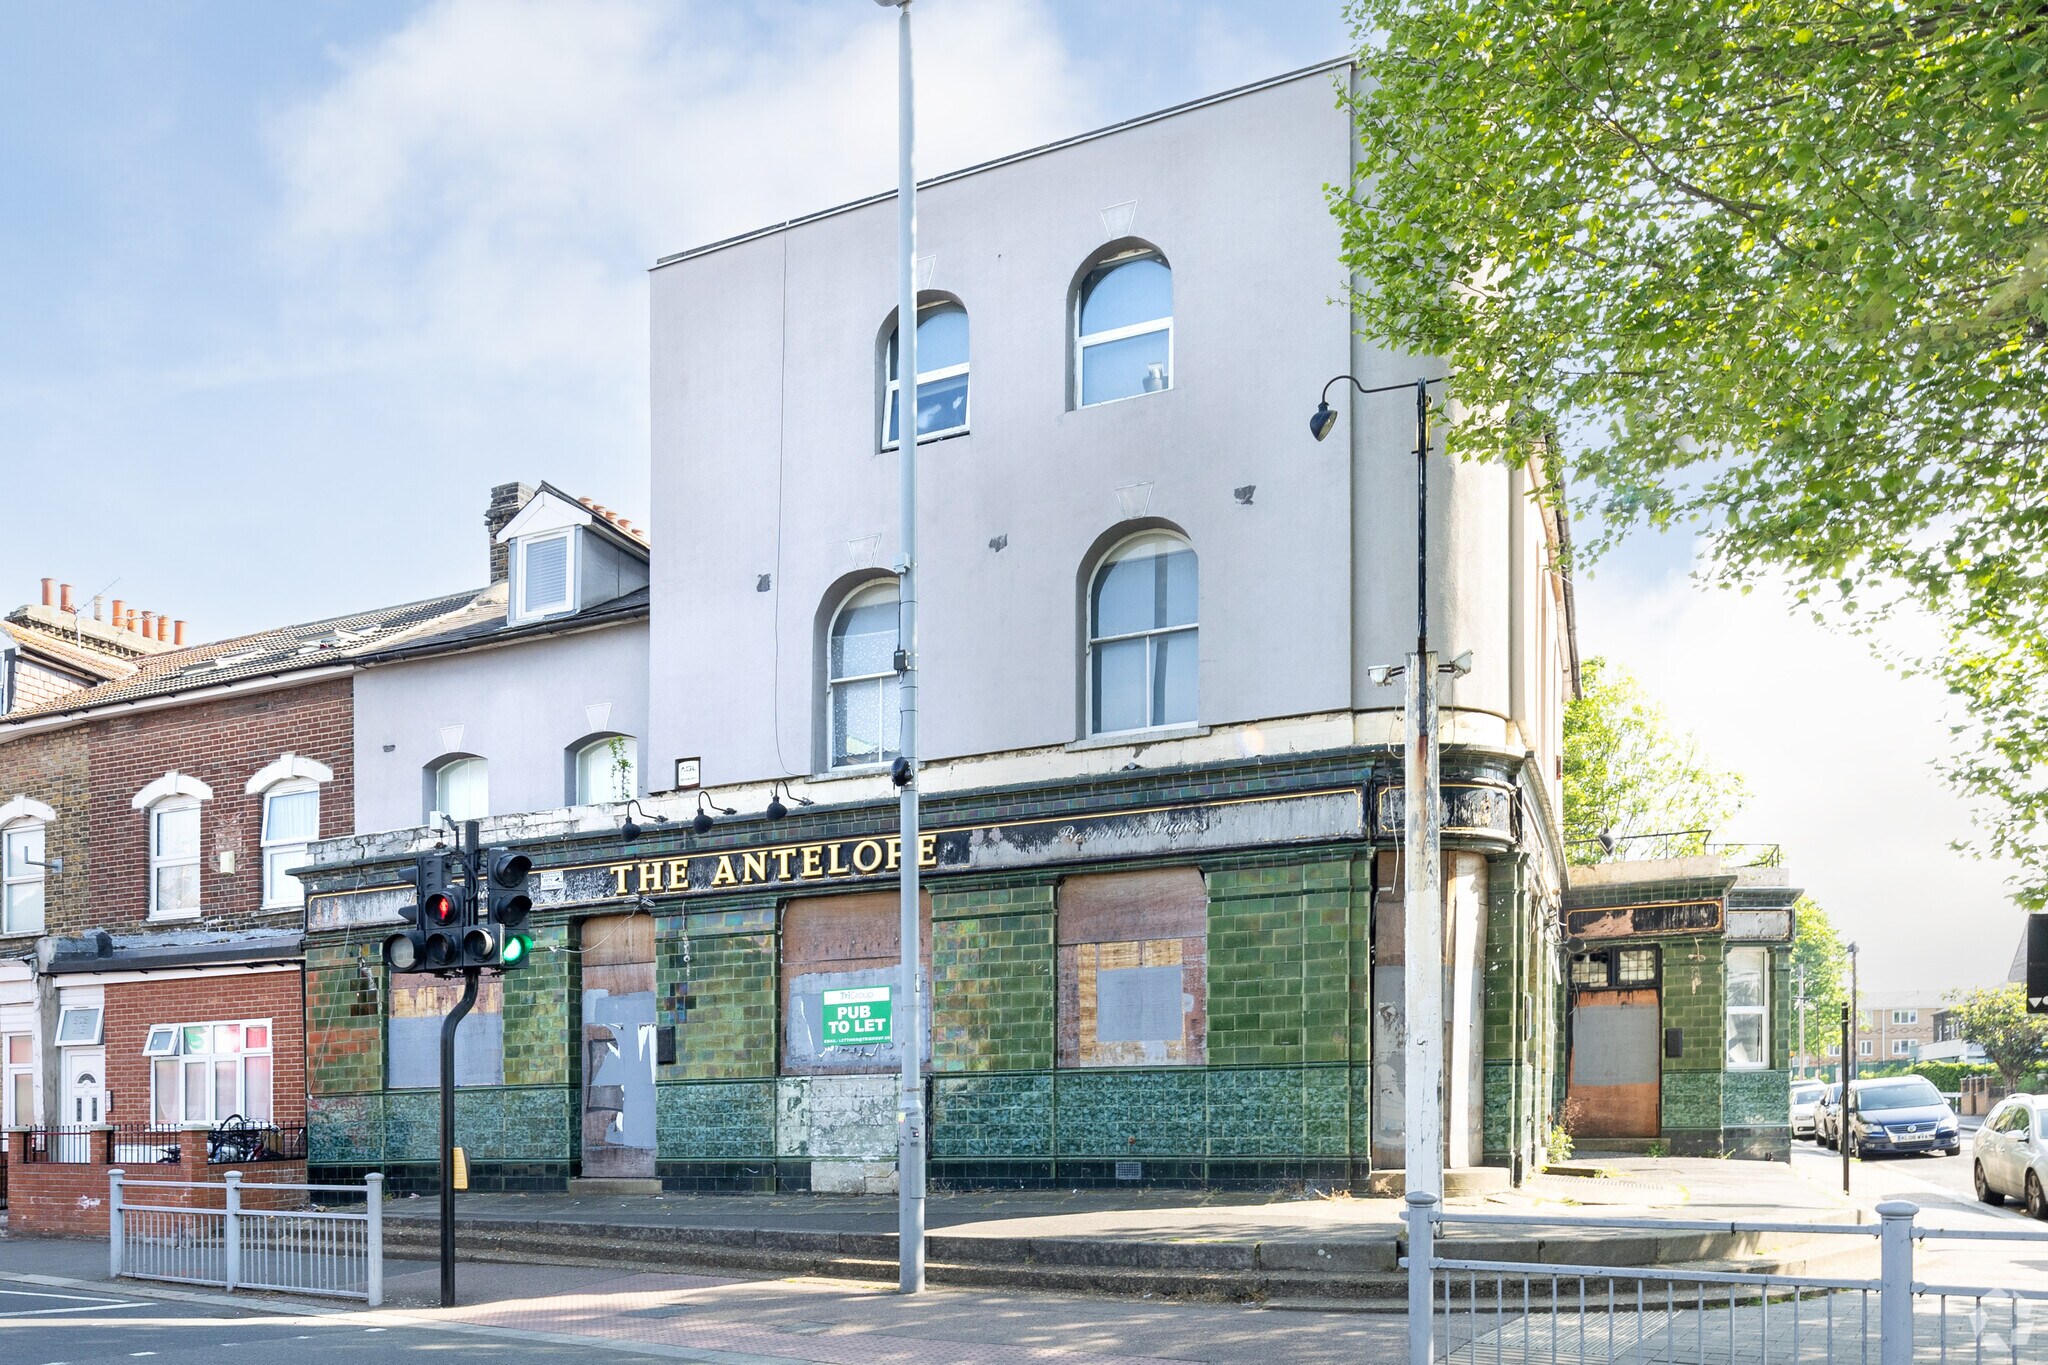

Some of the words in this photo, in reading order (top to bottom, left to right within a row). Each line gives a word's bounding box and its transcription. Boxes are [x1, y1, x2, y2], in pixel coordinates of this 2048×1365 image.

[610, 859, 689, 894] THE
[712, 835, 938, 885] ANTELOPE
[837, 1005, 871, 1019] PUB
[828, 1020, 850, 1034] TO
[854, 1018, 886, 1033] LET
